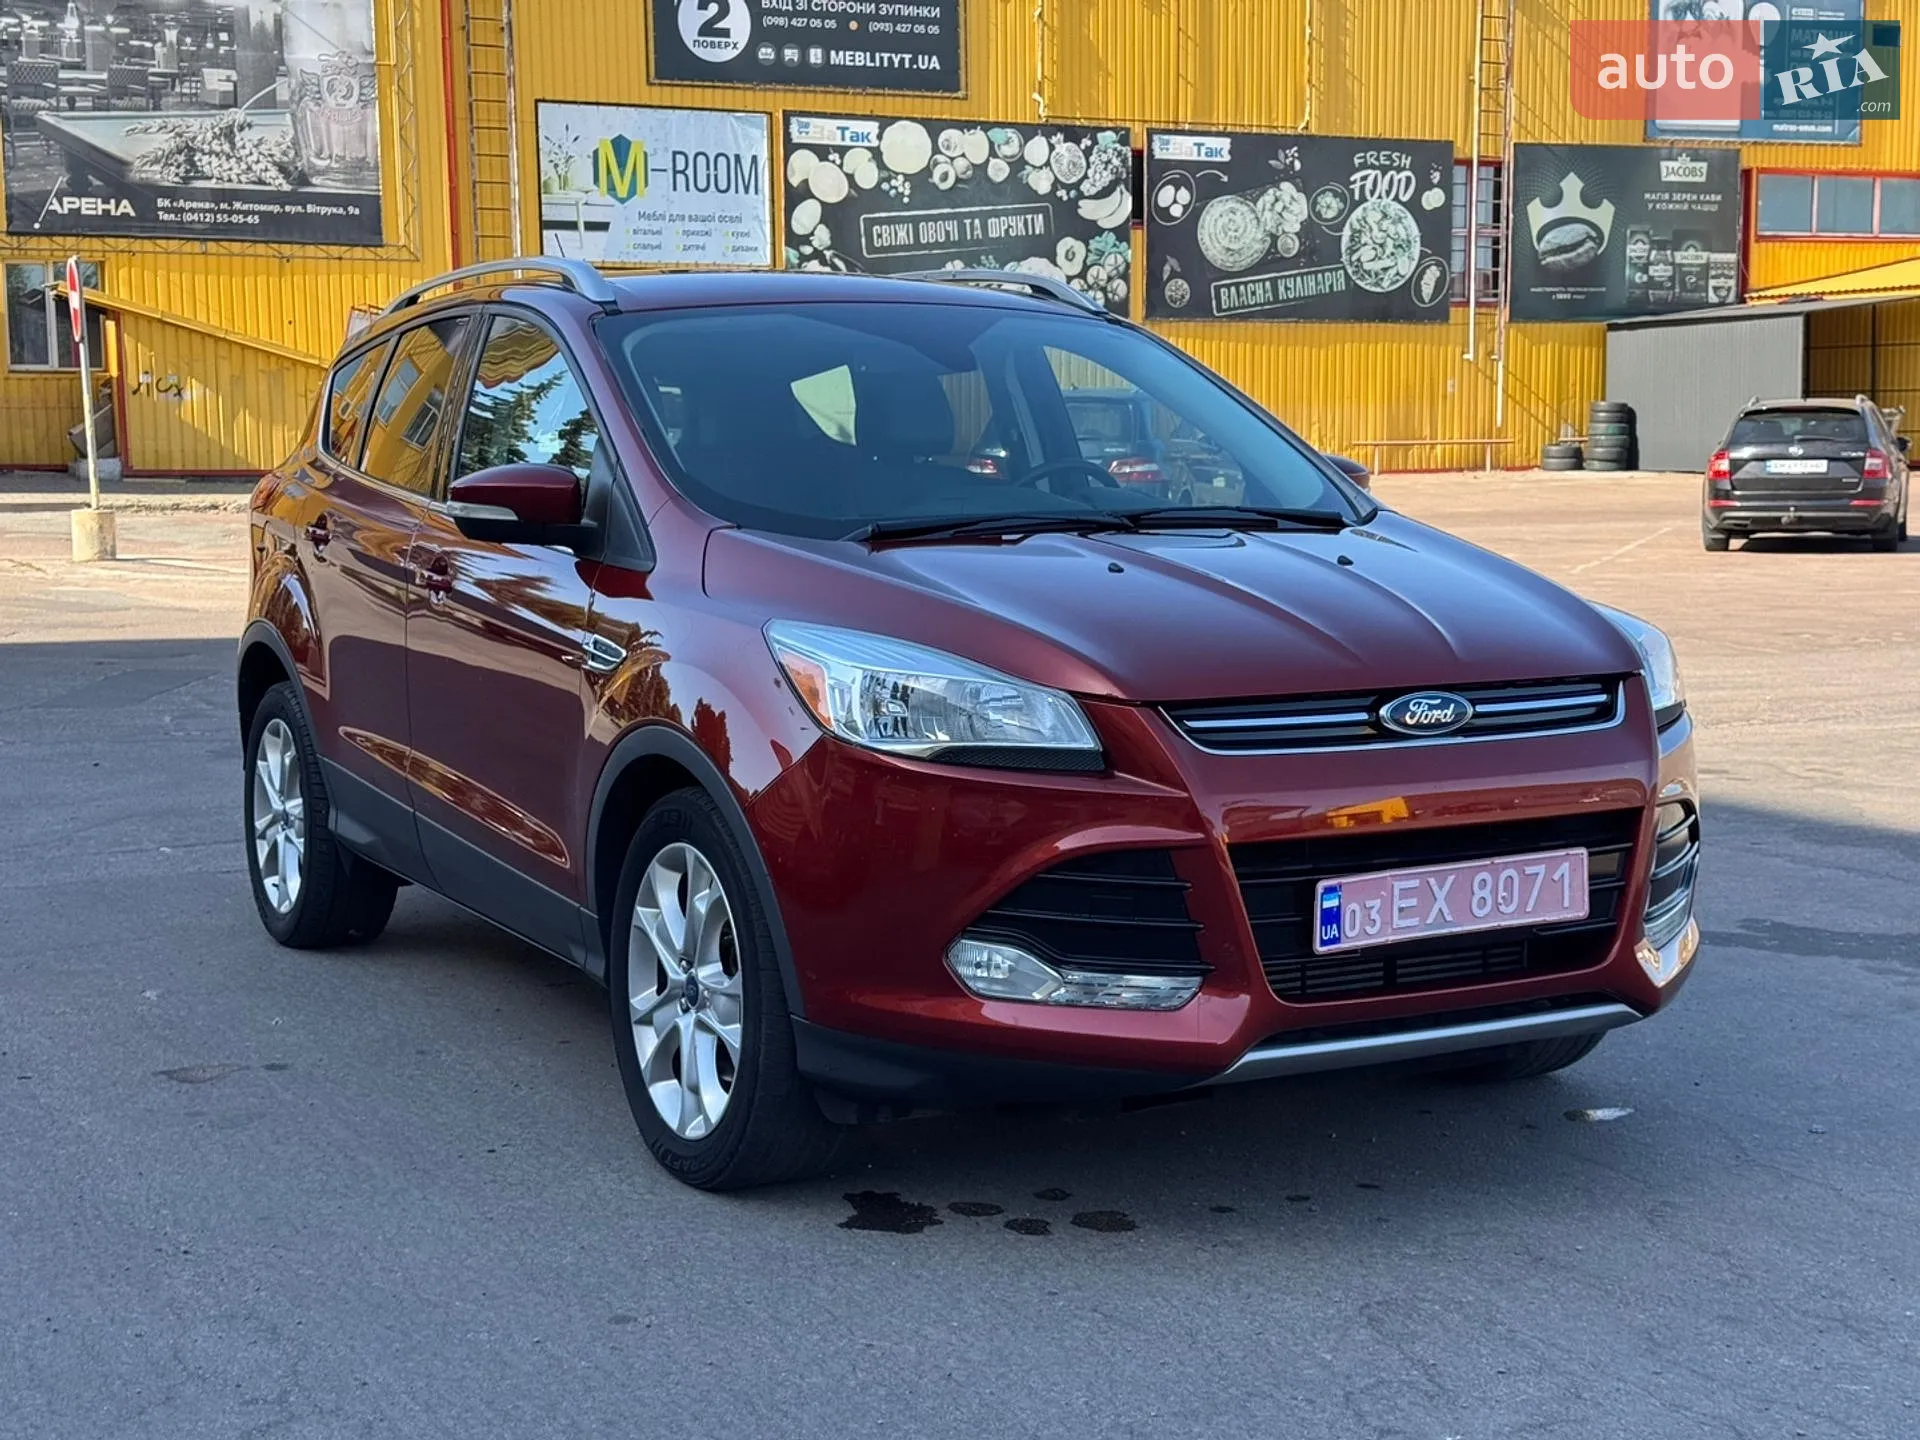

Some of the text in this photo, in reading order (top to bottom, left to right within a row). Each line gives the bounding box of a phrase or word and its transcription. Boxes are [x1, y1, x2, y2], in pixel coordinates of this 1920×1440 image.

[697, 0, 731, 38] 2
[811, 0, 876, 15] СТОРОНИ
[879, 5, 941, 19] ЗУПИНКИ
[763, 16, 837, 29] (098) 427 05 05
[868, 22, 940, 35] (093) 427 05 05
[692, 40, 739, 51] ПОВЕРХ
[829, 51, 941, 70] MEBLITYT.UA
[598, 137, 759, 196] M-ROOM
[1353, 151, 1412, 169] FRESH
[1663, 166, 1704, 178] JACOBS
[1350, 169, 1416, 202] FOOD
[1643, 192, 1670, 201] МАГІЯ
[48, 197, 136, 217] АРЕНА
[157, 198, 171, 208] БК
[172, 199, 218, 211] «Арена»,
[220, 202, 231, 211] м.
[233, 201, 283, 215] Житомир,
[285, 205, 305, 214] вул.
[306, 204, 347, 217] Вітрука,
[158, 211, 260, 225] Тел.: (0412) 55-05-65
[637, 210, 743, 224] Меблі для вашої оселі
[872, 213, 1045, 248] СВІЖІ ОВОЧІ ТА ФРУКТИ
[632, 241, 662, 251] спальні
[1220, 269, 1346, 309] ВЛАСНА КУЛІНАРІЯ
[1404, 699, 1455, 725] Ford
[1321, 924, 1340, 941] UA
[1470, 860, 1573, 918] 8071
